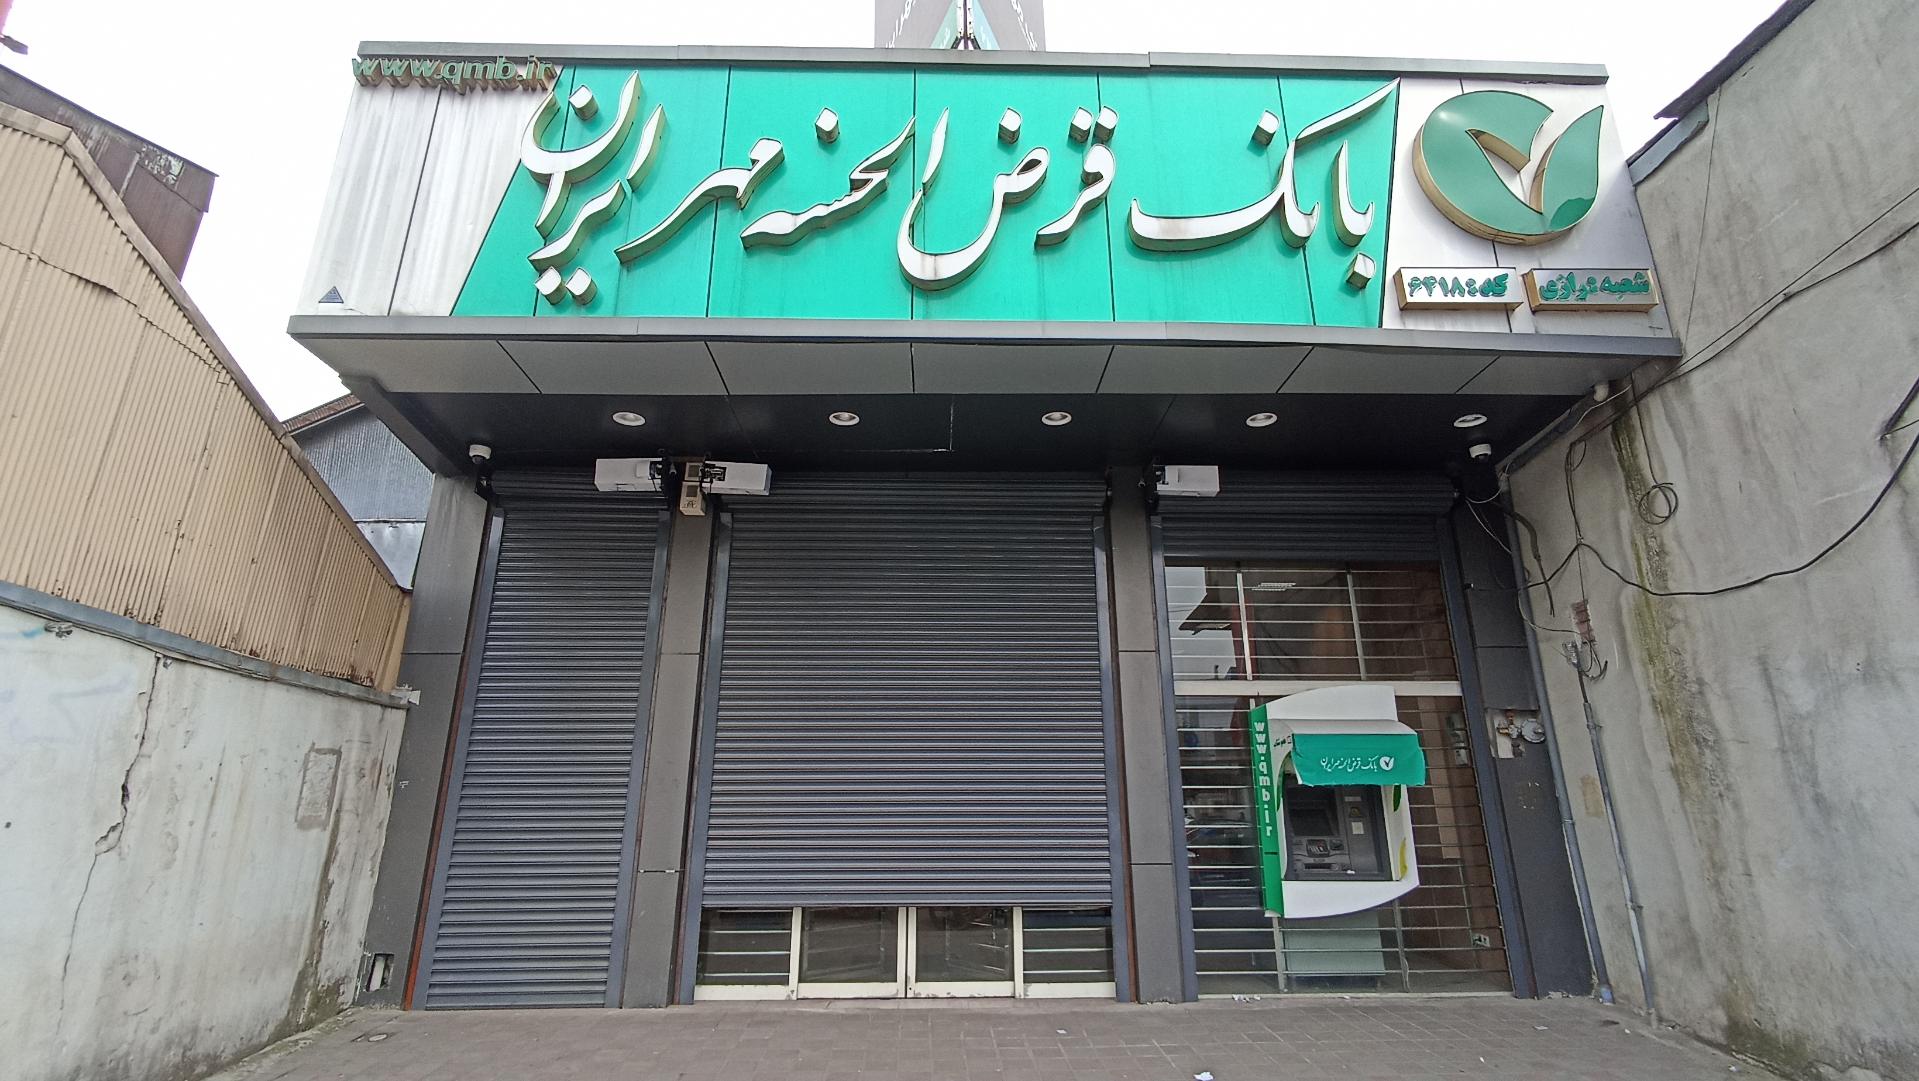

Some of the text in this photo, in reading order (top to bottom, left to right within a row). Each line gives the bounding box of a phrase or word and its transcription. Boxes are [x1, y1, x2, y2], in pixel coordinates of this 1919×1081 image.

[351, 55, 557, 92] www.qmb.ir
[519, 70, 1400, 305] بانک قرض الحسنه مهر ایران
[1600, 271, 1650, 301] شعبه
[1346, 757, 1361, 772] قرض
[1360, 755, 1379, 772] بانک
